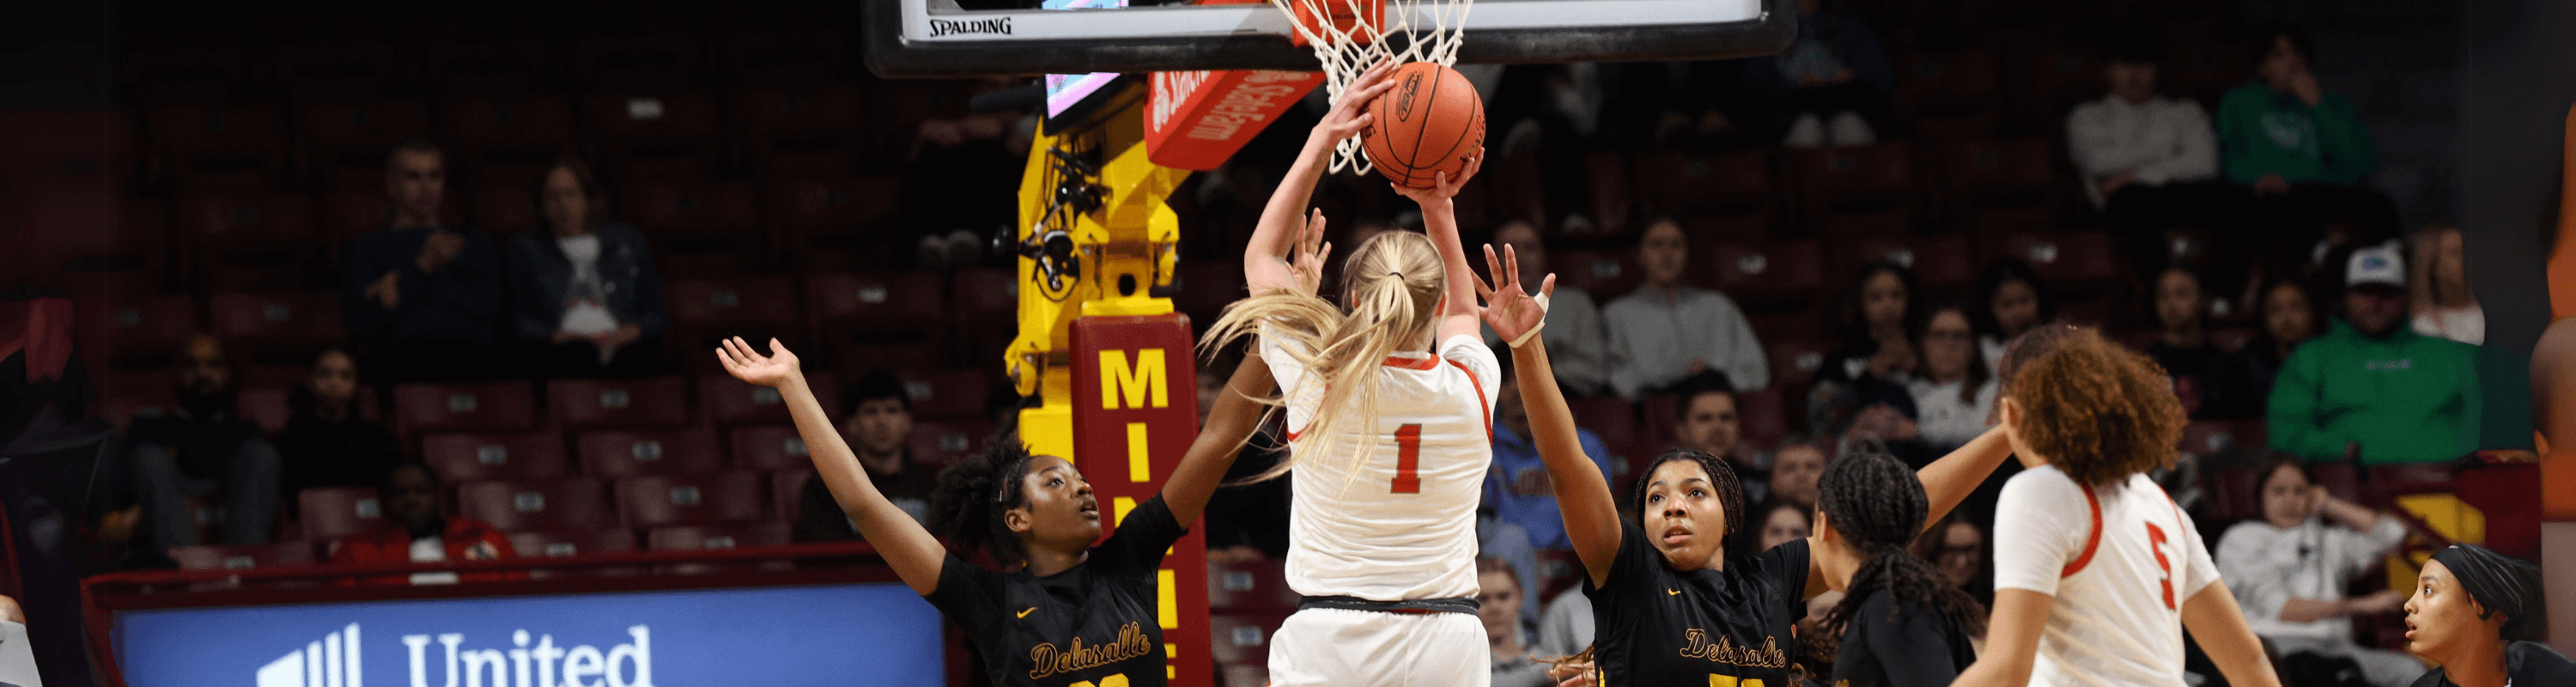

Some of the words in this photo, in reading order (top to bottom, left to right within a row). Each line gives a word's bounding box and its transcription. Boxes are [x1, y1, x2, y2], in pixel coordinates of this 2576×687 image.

[930, 17, 1012, 37] SPALDING
[1390, 423, 1422, 494] 1
[2145, 521, 2177, 611] 5
[401, 624, 653, 687] United
